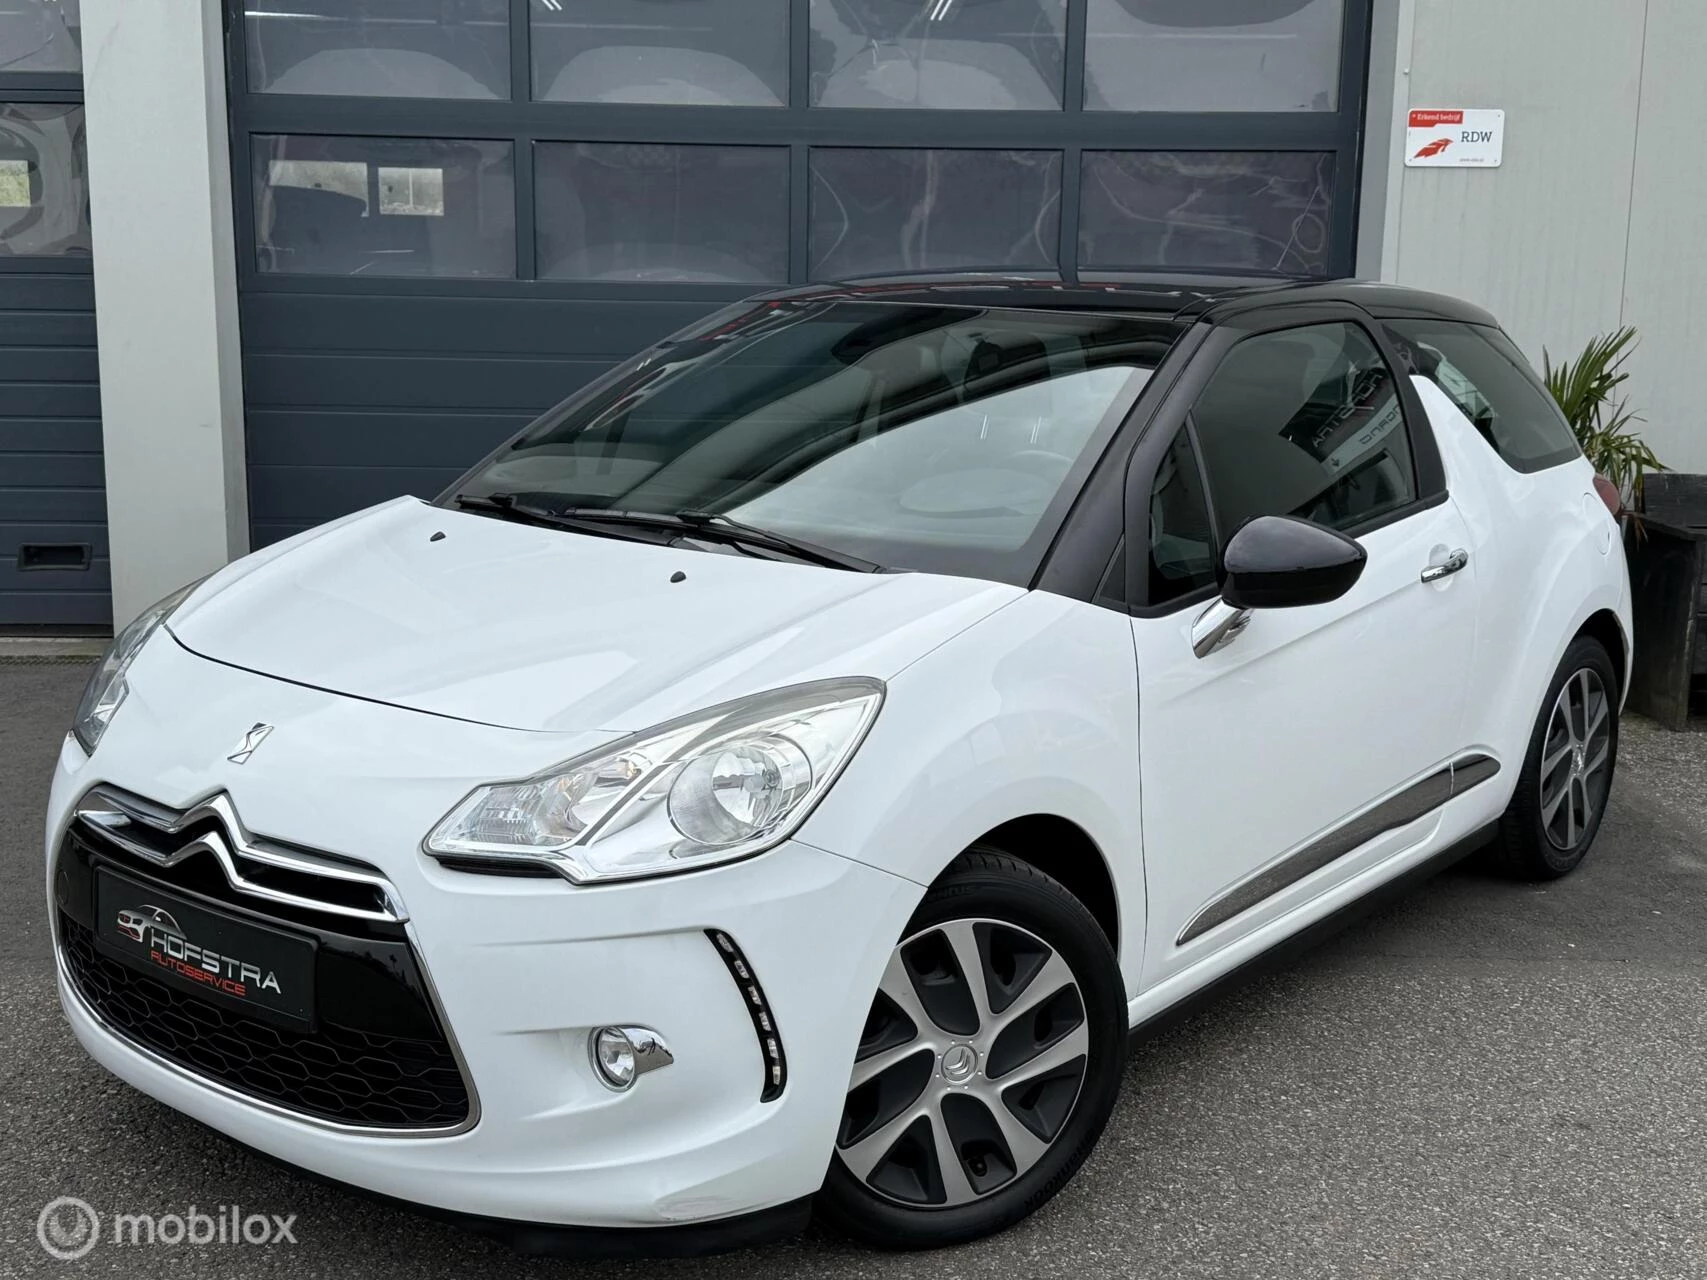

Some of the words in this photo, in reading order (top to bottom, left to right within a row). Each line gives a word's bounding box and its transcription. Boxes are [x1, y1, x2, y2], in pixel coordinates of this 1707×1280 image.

[1460, 131, 1493, 143] RDW
[151, 928, 281, 995] HOFSTRA
[151, 951, 247, 996] AUTOSERVICE
